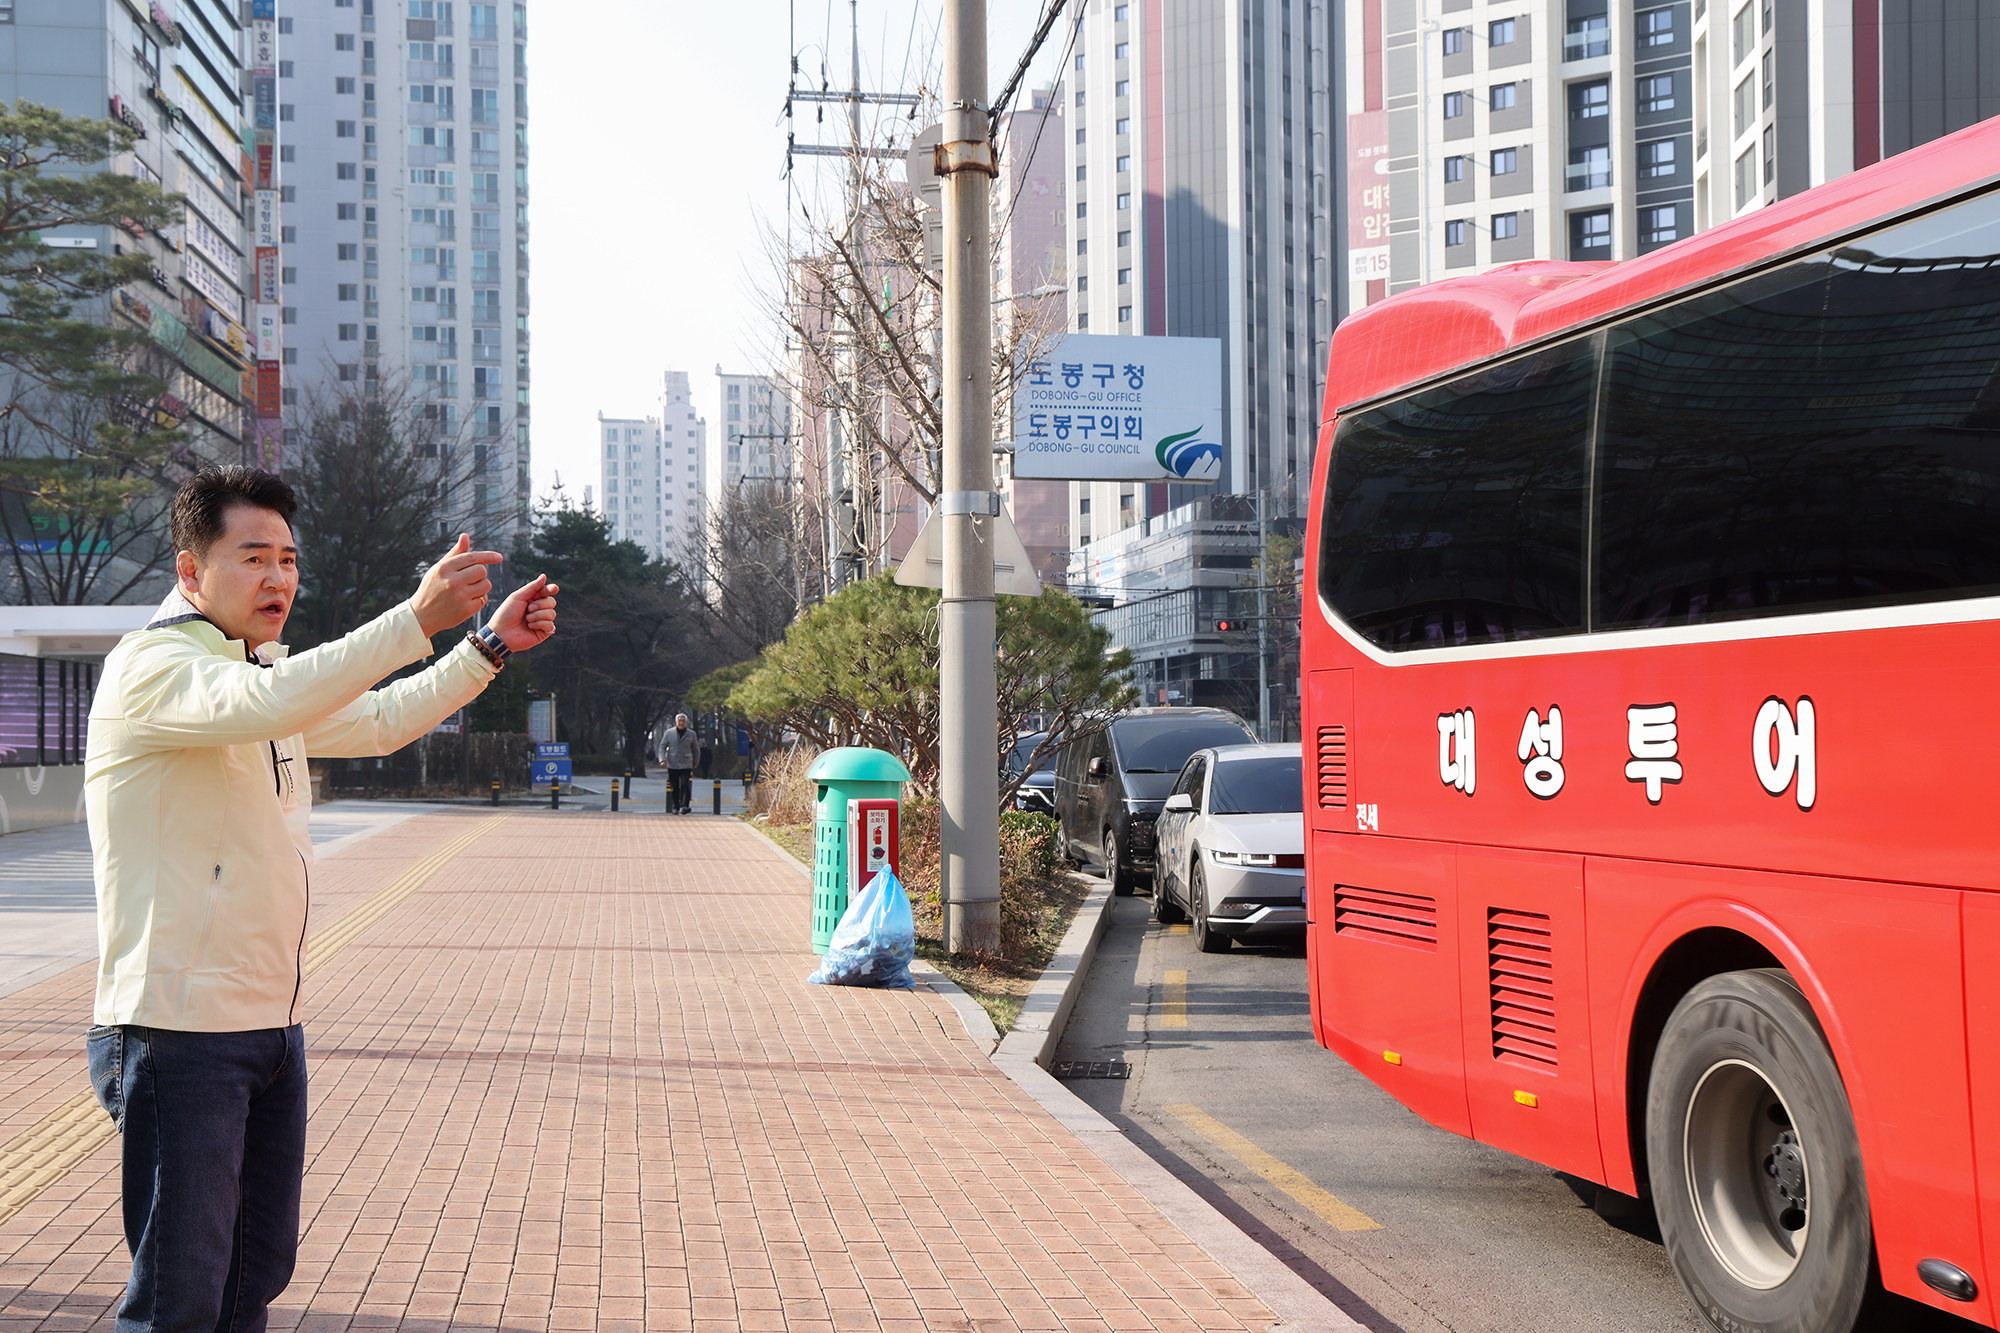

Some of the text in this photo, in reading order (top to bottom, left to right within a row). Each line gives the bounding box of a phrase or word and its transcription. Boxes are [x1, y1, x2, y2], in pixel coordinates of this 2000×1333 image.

[1370, 253, 1390, 272] 15
[1030, 362, 1145, 391] 도봉구청
[1031, 389, 1142, 403] DOBONG-GU OFFICE
[1029, 413, 1142, 441] 도봉구의회
[1028, 442, 1141, 455] DOBONG-GU COUNCIL
[1436, 694, 1817, 813] 대성투어
[1356, 803, 1379, 832] 전세
